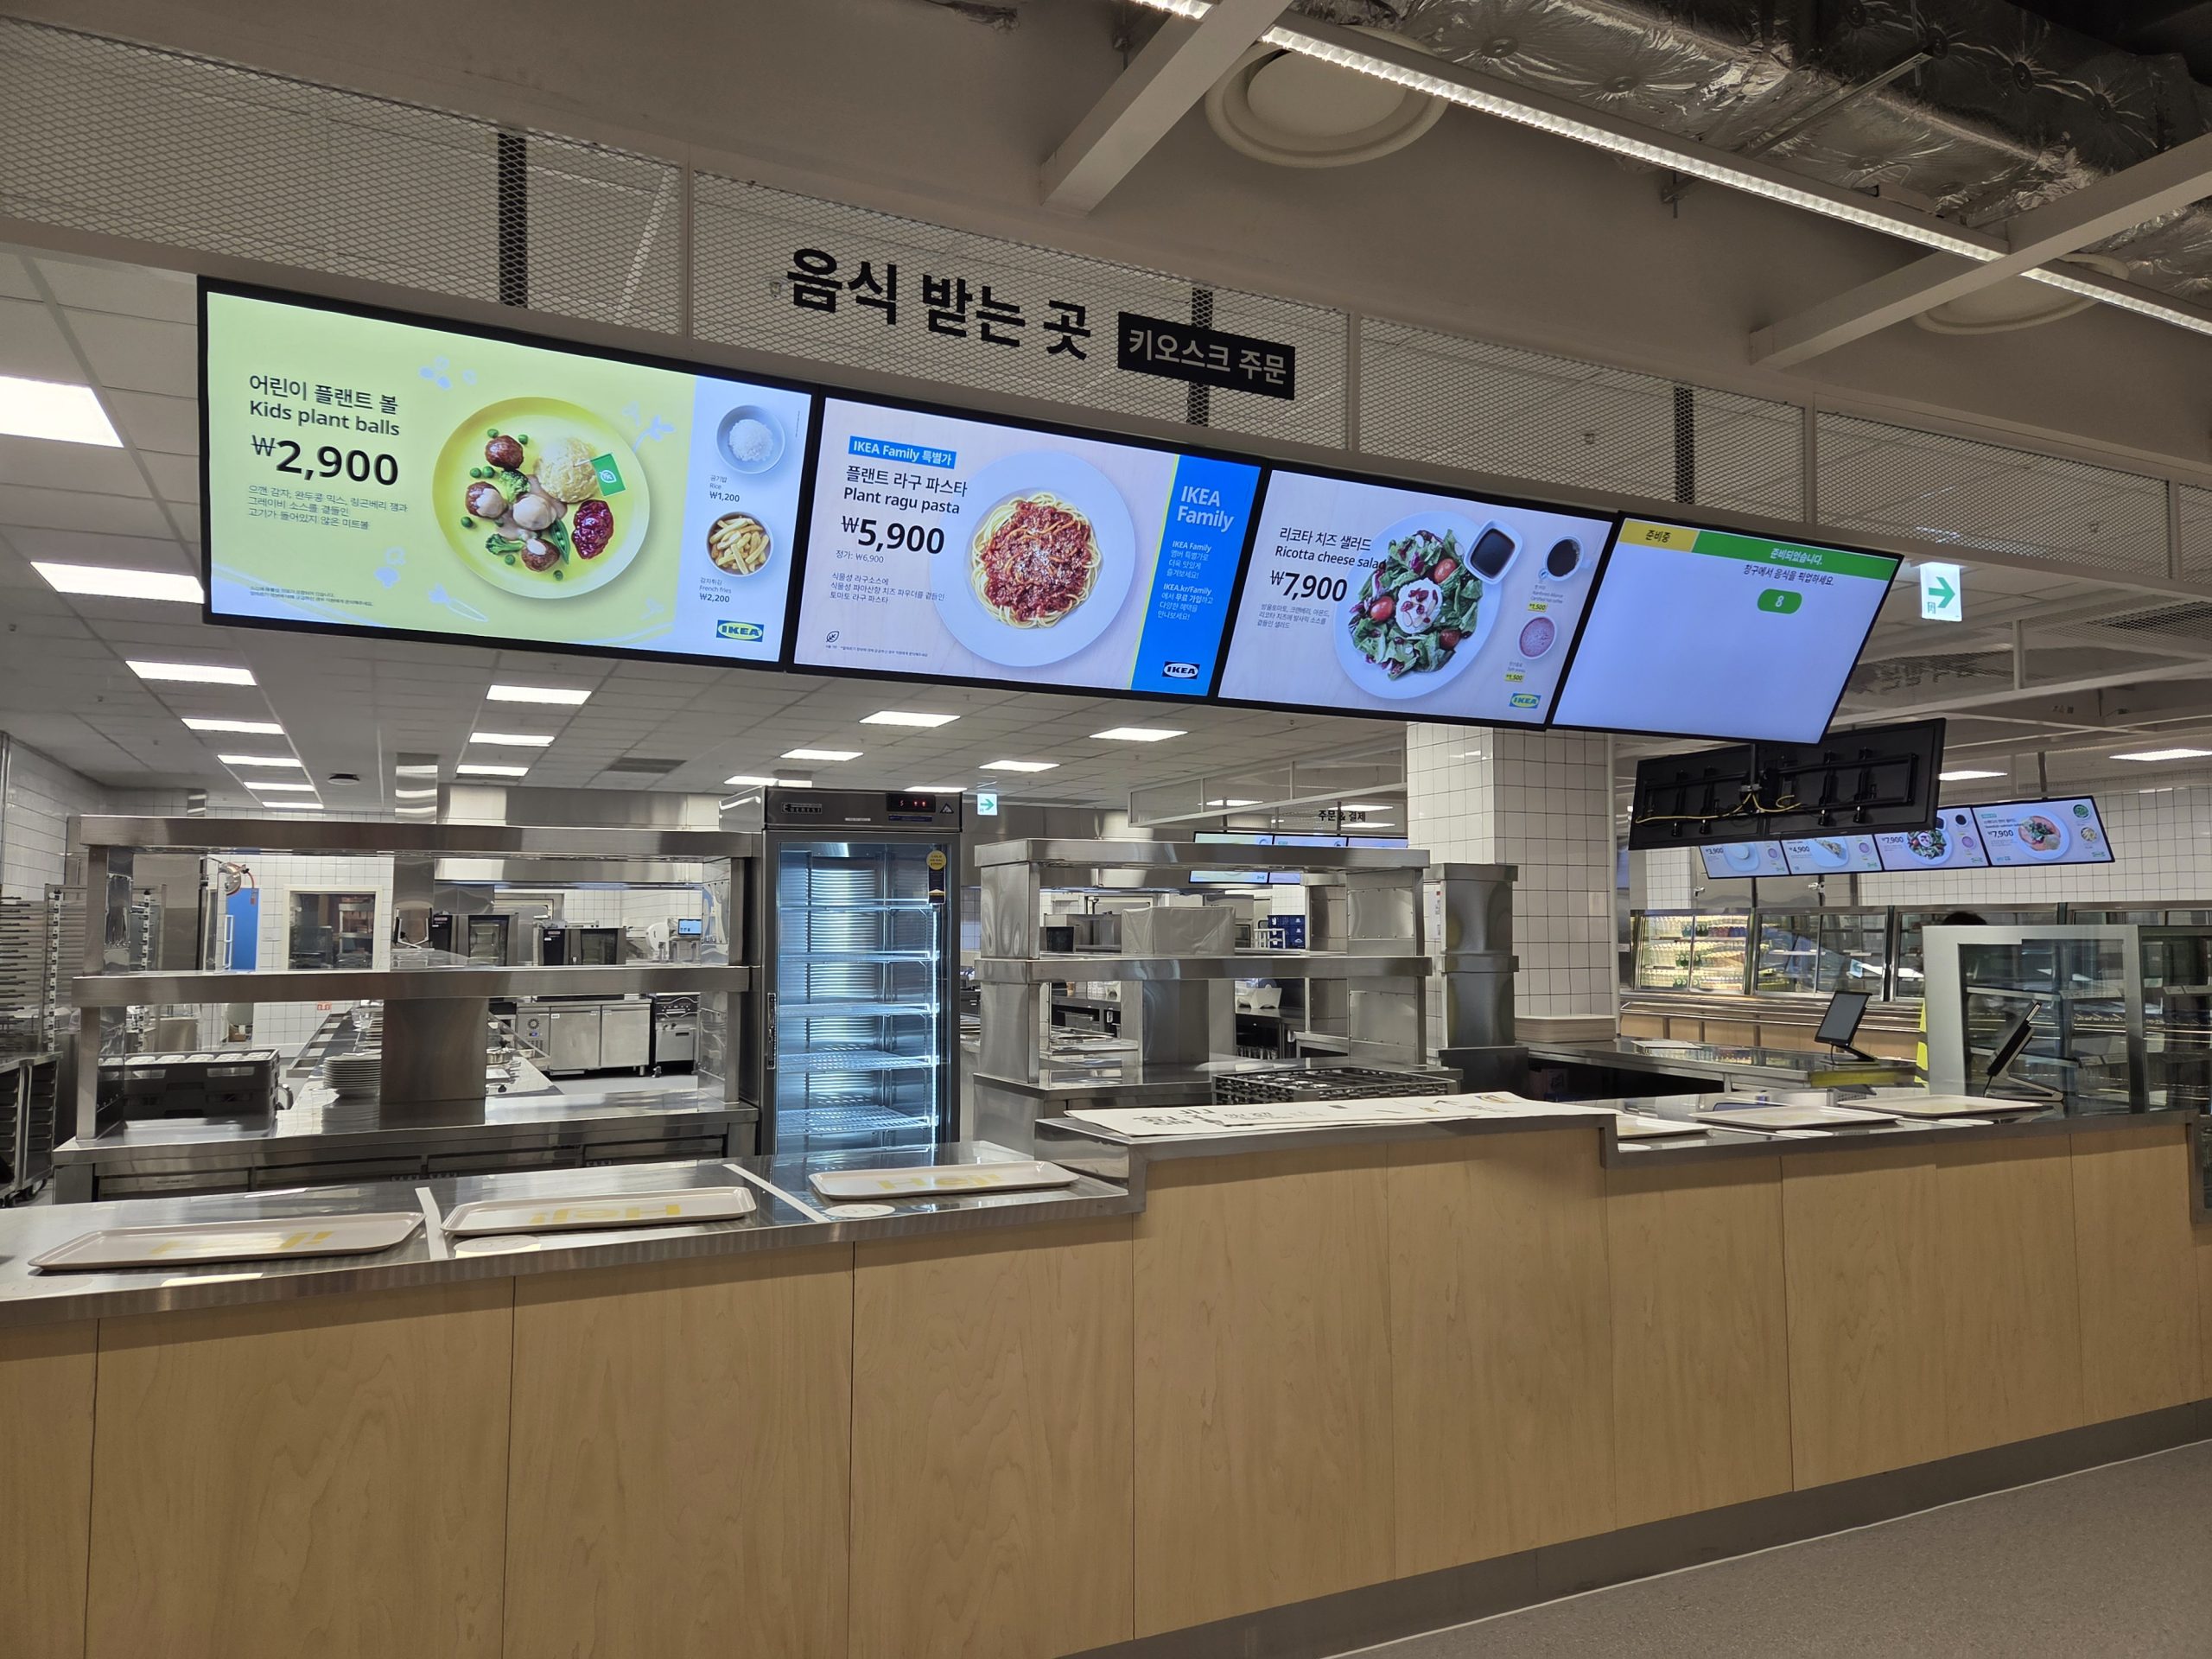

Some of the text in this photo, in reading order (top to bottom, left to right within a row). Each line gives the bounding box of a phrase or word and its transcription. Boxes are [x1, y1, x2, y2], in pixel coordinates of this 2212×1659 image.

[787, 248, 1091, 361] 음식 받는 곳
[1128, 328, 1287, 385] 키오스크 주문
[249, 374, 399, 415] 어린이 플랜트 볼
[249, 399, 400, 435] Kids plant balls
[250, 434, 399, 486] ₩2,900
[853, 441, 952, 466] IKEA Family 특별가
[846, 465, 968, 498] 플랜트 라구 파스타
[248, 485, 269, 495] 으깬
[270, 487, 292, 499] 감자,
[295, 490, 323, 503] 완두콩
[326, 494, 347, 505] 믹스,
[248, 496, 286, 509] 그레이비
[289, 502, 318, 513] 소스를
[843, 487, 960, 514] Plant ragu pasta
[1180, 486, 1221, 507] IKEA
[248, 507, 276, 518] 고기가
[342, 519, 369, 530] 미트볼
[1177, 506, 1235, 532] Family
[841, 515, 945, 555] ₩5,900
[1280, 526, 1372, 551] 리코타 치즈 샐러드
[1645, 529, 1672, 543] 준비중
[836, 550, 854, 561] 정가:
[1173, 540, 1211, 553] IKEA Family
[1275, 545, 1315, 561] Ricotta
[1317, 551, 1356, 566] cheese
[1770, 548, 1823, 566] 준비되었습니다.
[1269, 569, 1348, 601] ₩7,900
[1743, 564, 1834, 586] 창구에서 음식을 픽업하세요.
[830, 591, 889, 604] 토마토 라구 파스타
[881, 588, 896, 596] 치즈
[1163, 582, 1212, 596] IKEA.kr/Family
[1775, 595, 1784, 607] 8
[721, 625, 760, 637] IKEA
[1166, 665, 1196, 676] IKEA
[1319, 810, 1336, 821] 주문
[1349, 810, 1366, 822] 결제
[877, 1173, 1007, 1190] Hej!
